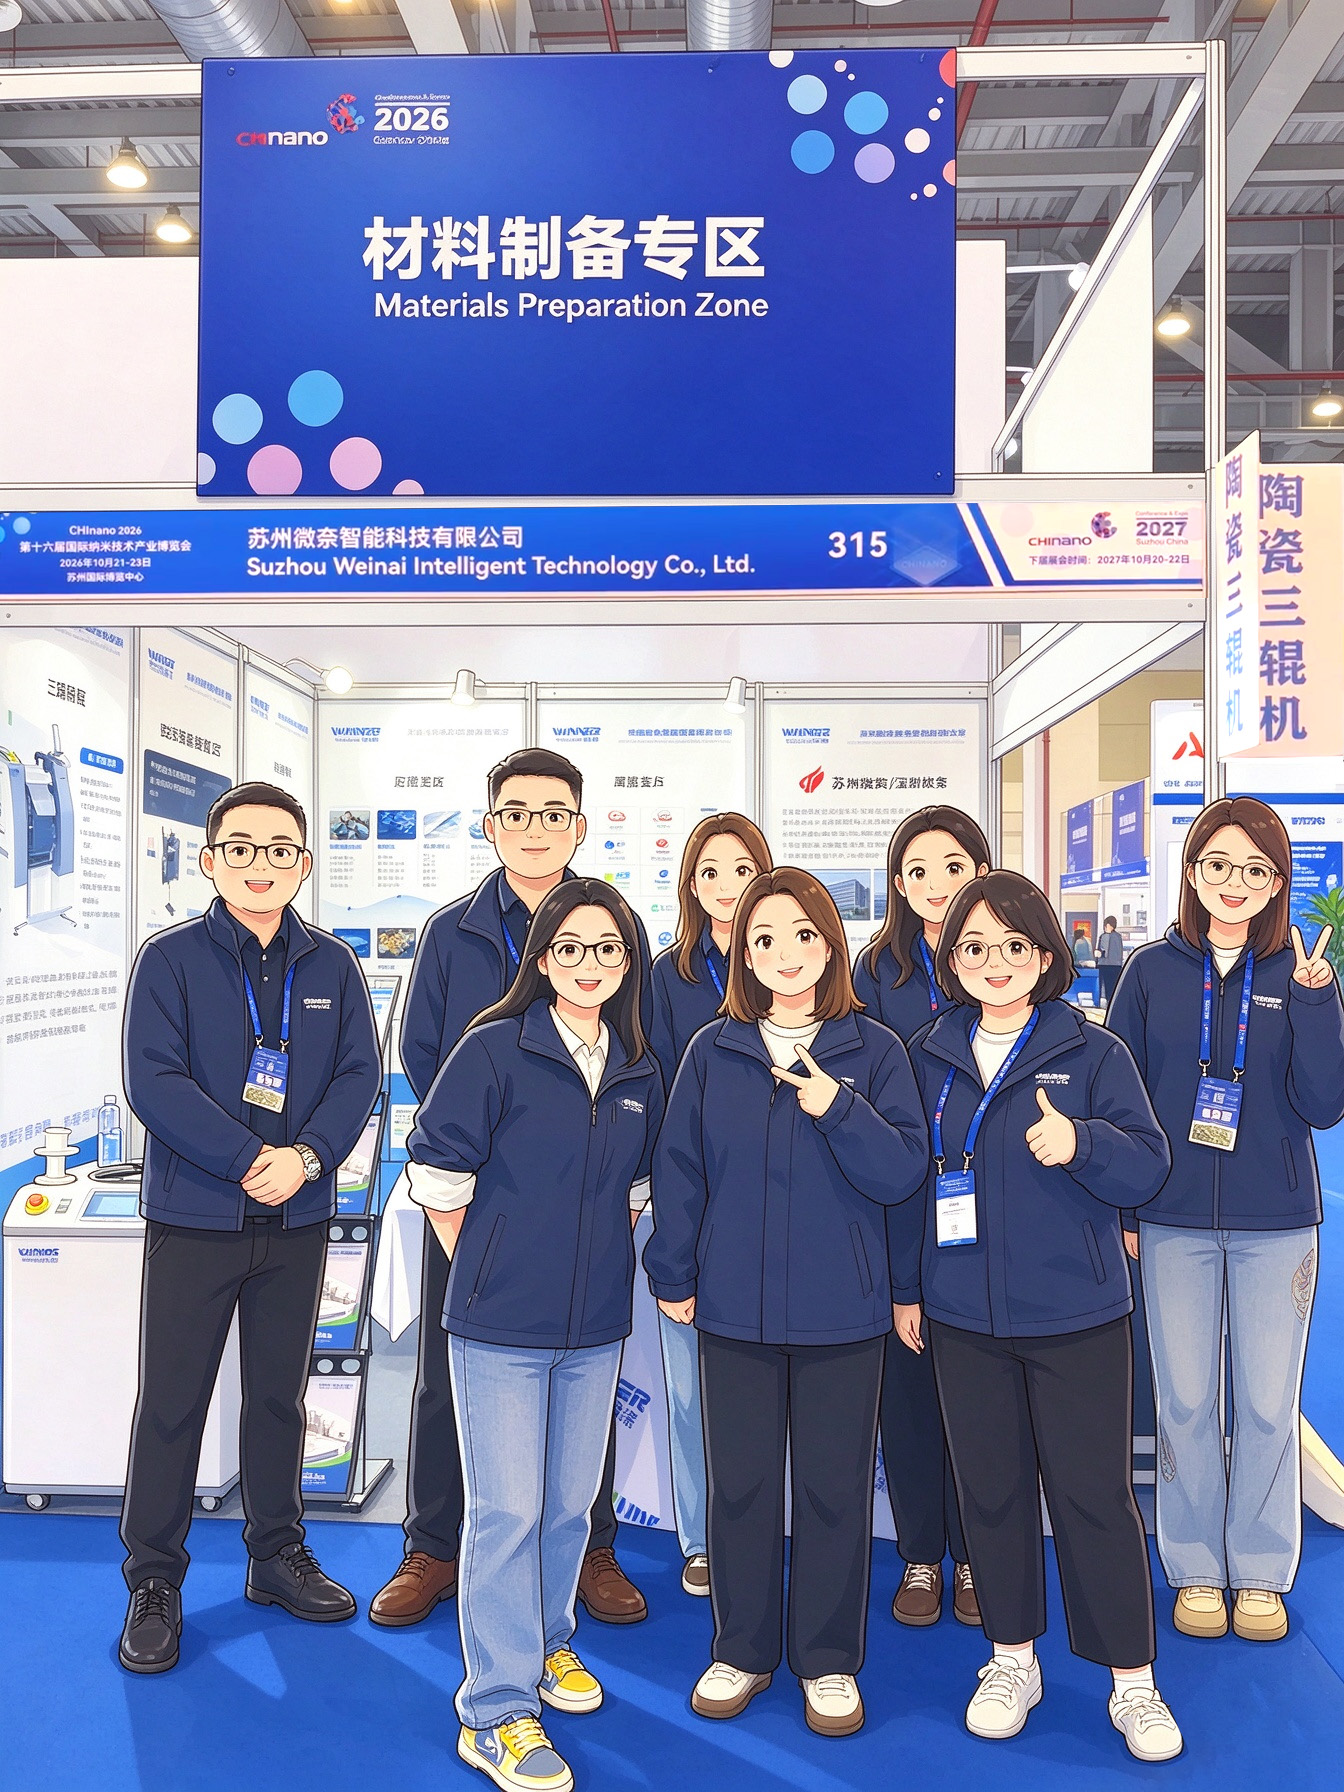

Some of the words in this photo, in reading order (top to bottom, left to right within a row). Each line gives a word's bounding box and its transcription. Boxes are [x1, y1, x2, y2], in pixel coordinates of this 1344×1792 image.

[373, 107, 449, 131] 2026
[362, 213, 765, 282] 材料制备专区
[375, 291, 509, 319] Materials
[518, 292, 687, 323] Preparation
[694, 292, 769, 318] Zone
[118, 526, 142, 536] 2026
[247, 525, 524, 550] 苏州微奈智能科技有限公司
[1136, 521, 1187, 537] 2027
[19, 540, 192, 553] 第十六届国际纳米技术产业博览会
[828, 530, 888, 559] 315
[1135, 537, 1165, 546] Suzhou
[1166, 537, 1189, 546] China
[59, 557, 151, 569] 2026年10月21-23日
[246, 557, 327, 577] Suzhou
[332, 557, 407, 576] Weinai
[414, 555, 527, 581] Intelligent
[532, 555, 658, 580] Technology
[664, 555, 706, 577] Co.,
[713, 554, 755, 574] Ltd.
[67, 571, 145, 583] 苏州国际博览中心
[1225, 453, 1243, 737] 陶瓷三辊机
[1259, 472, 1308, 742] 陶瓷三辊机
